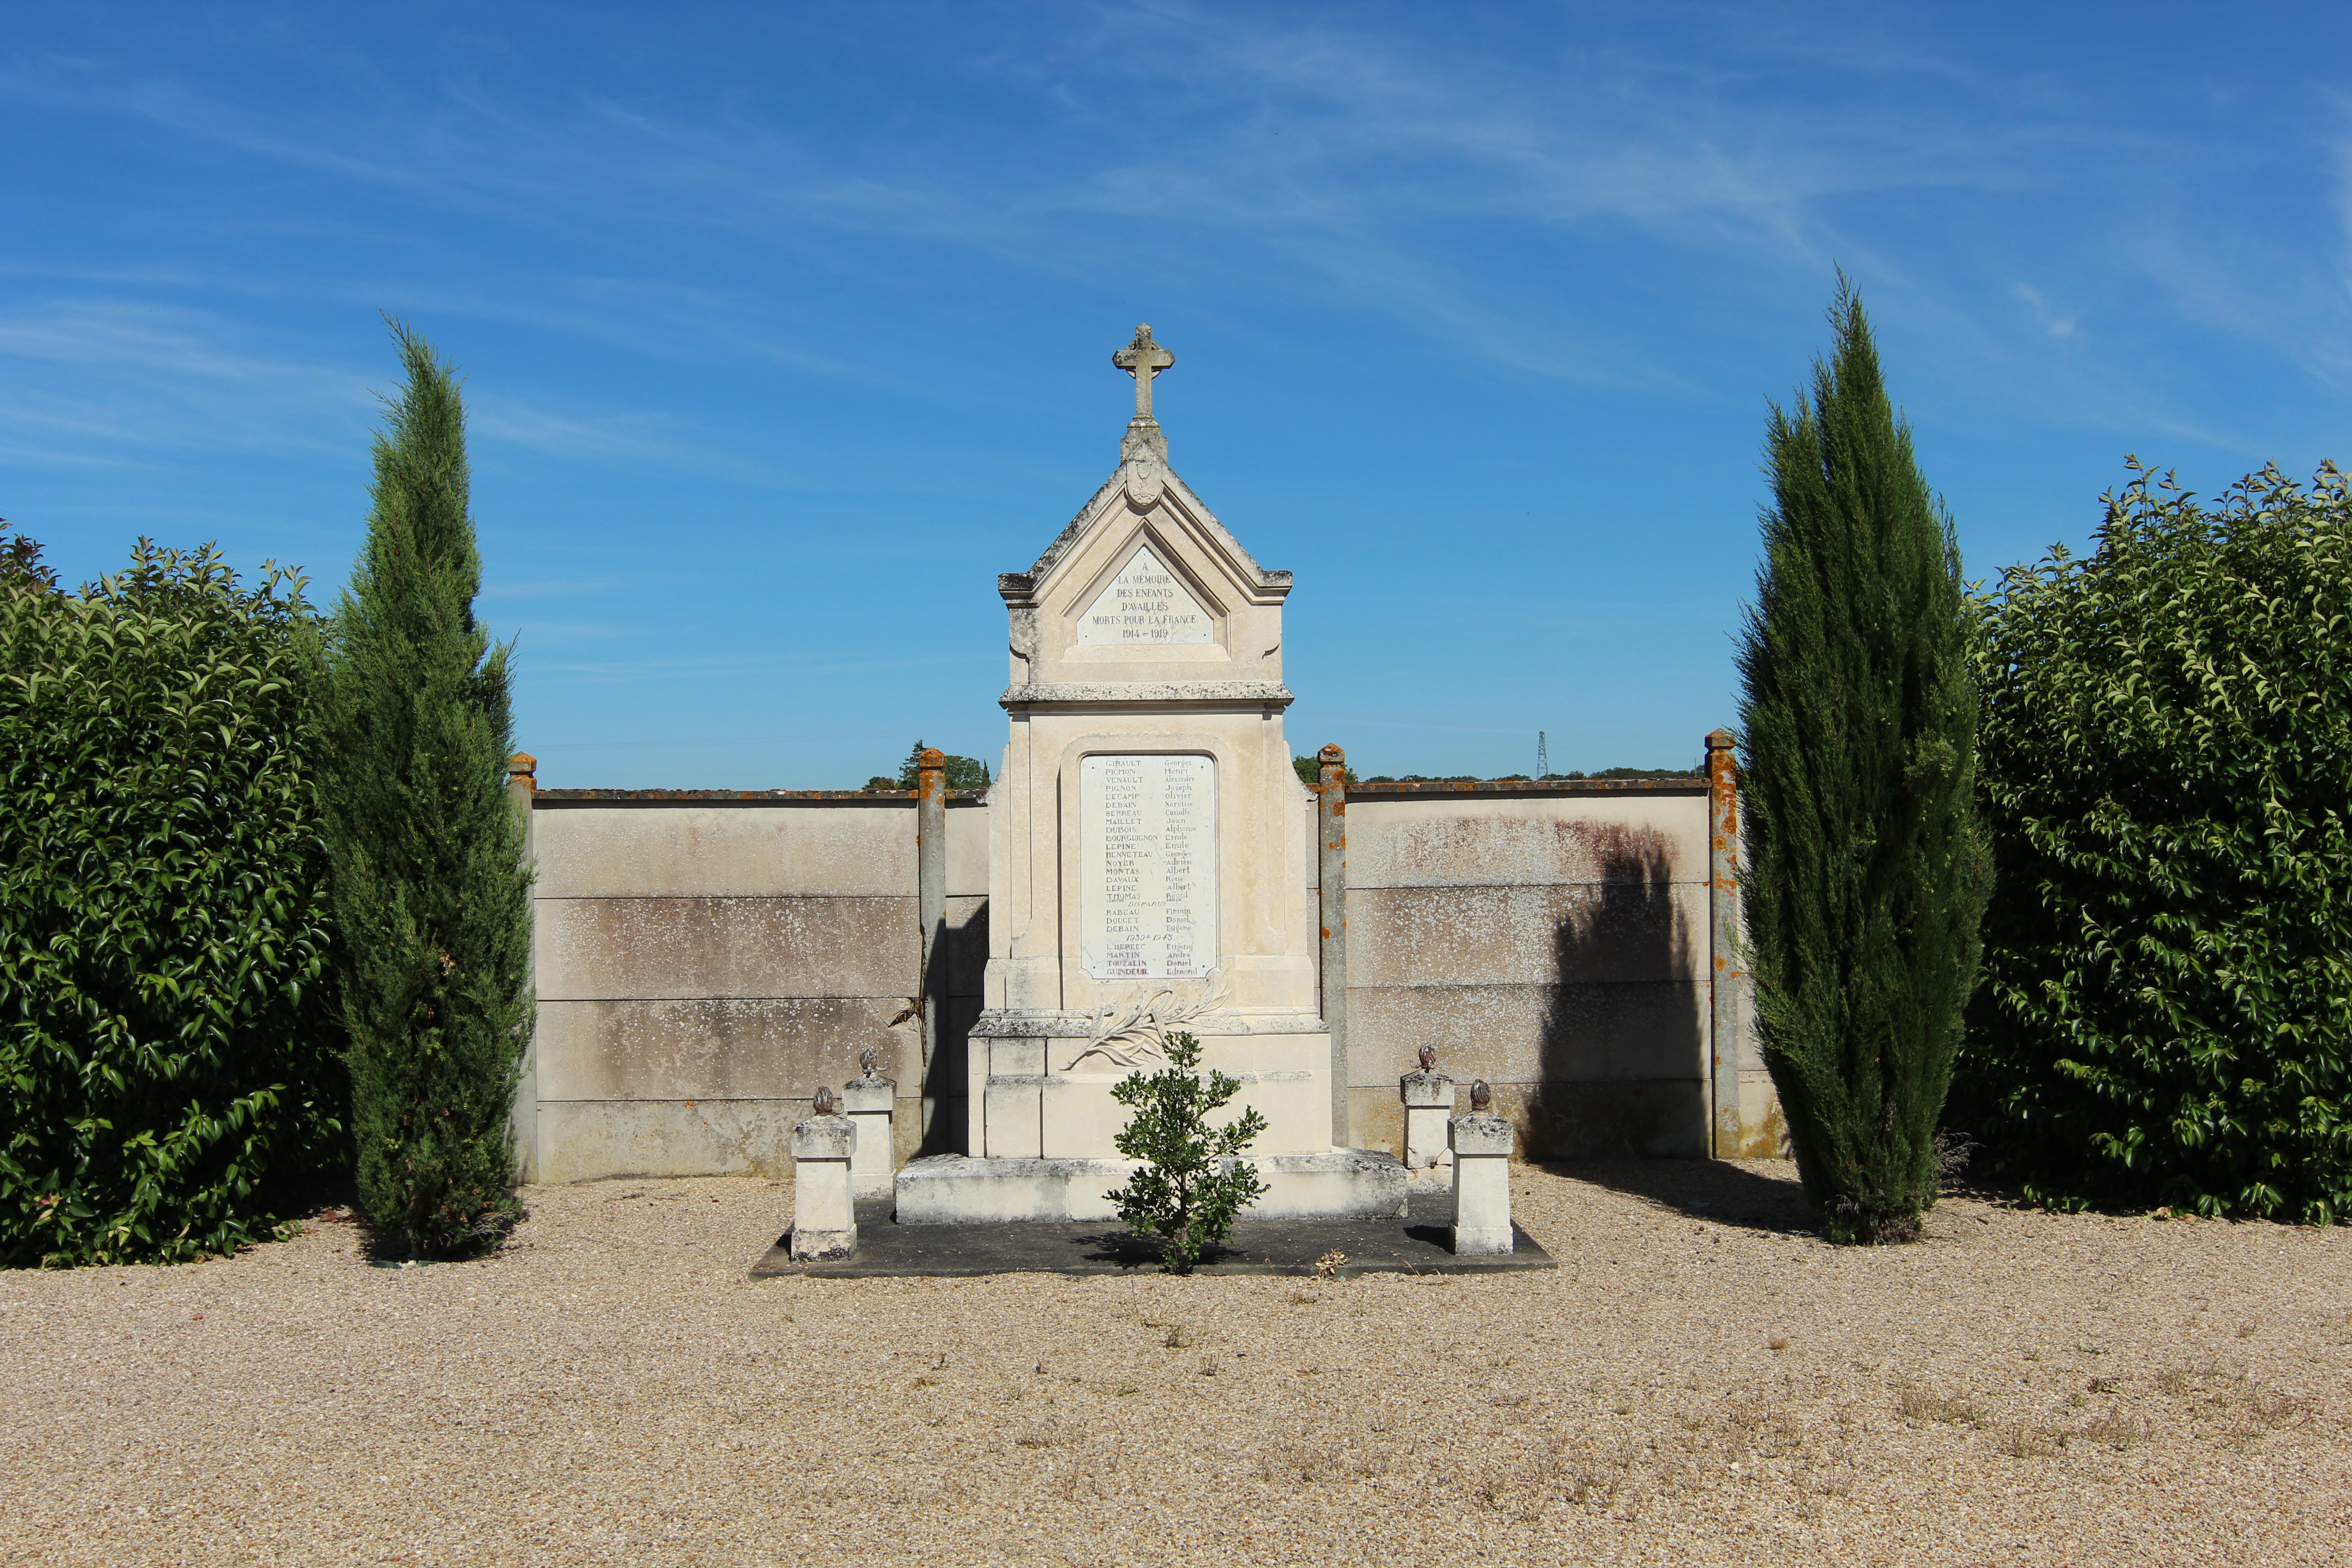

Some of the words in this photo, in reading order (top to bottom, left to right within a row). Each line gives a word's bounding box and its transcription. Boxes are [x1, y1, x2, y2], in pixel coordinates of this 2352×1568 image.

[1142, 563, 1149, 571] A
[1118, 576, 1129, 584] LA
[1117, 589, 1133, 598] DES
[1136, 588, 1173, 597] ENFANTS
[1122, 602, 1168, 611] D'AVAILLES
[1092, 616, 1121, 624] MORTS
[1124, 616, 1144, 624] POUR
[1148, 615, 1160, 624] LA
[1163, 615, 1196, 624] FRANCE
[1122, 629, 1140, 638] 1914
[1151, 629, 1168, 638] 1919
[1165, 760, 1191, 768] Georges
[1166, 784, 1192, 792] Joseph
[1166, 824, 1197, 833] Alphonse
[1165, 841, 1189, 849] Emile
[1166, 850, 1192, 859] Georges
[1166, 915, 1189, 923] Daniel
